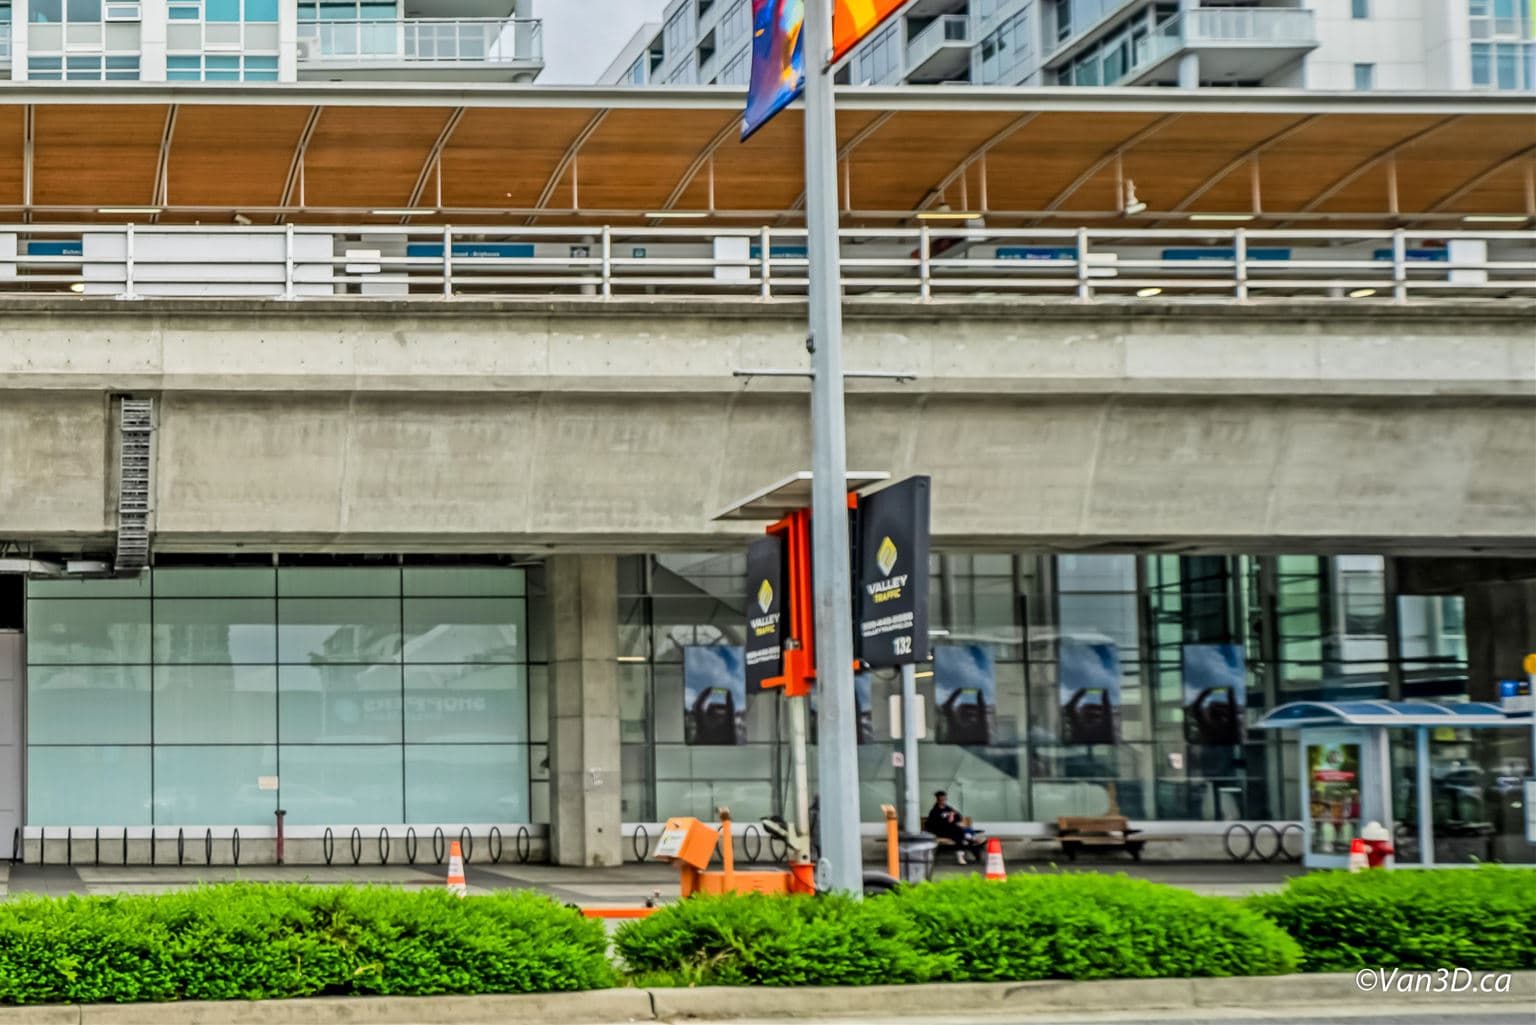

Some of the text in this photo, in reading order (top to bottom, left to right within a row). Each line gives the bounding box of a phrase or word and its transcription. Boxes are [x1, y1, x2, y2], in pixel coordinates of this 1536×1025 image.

[866, 575, 908, 595] VALLEY
[873, 588, 902, 604] TRAFFIC
[750, 612, 780, 629] VALLEY
[893, 636, 912, 656] 132
